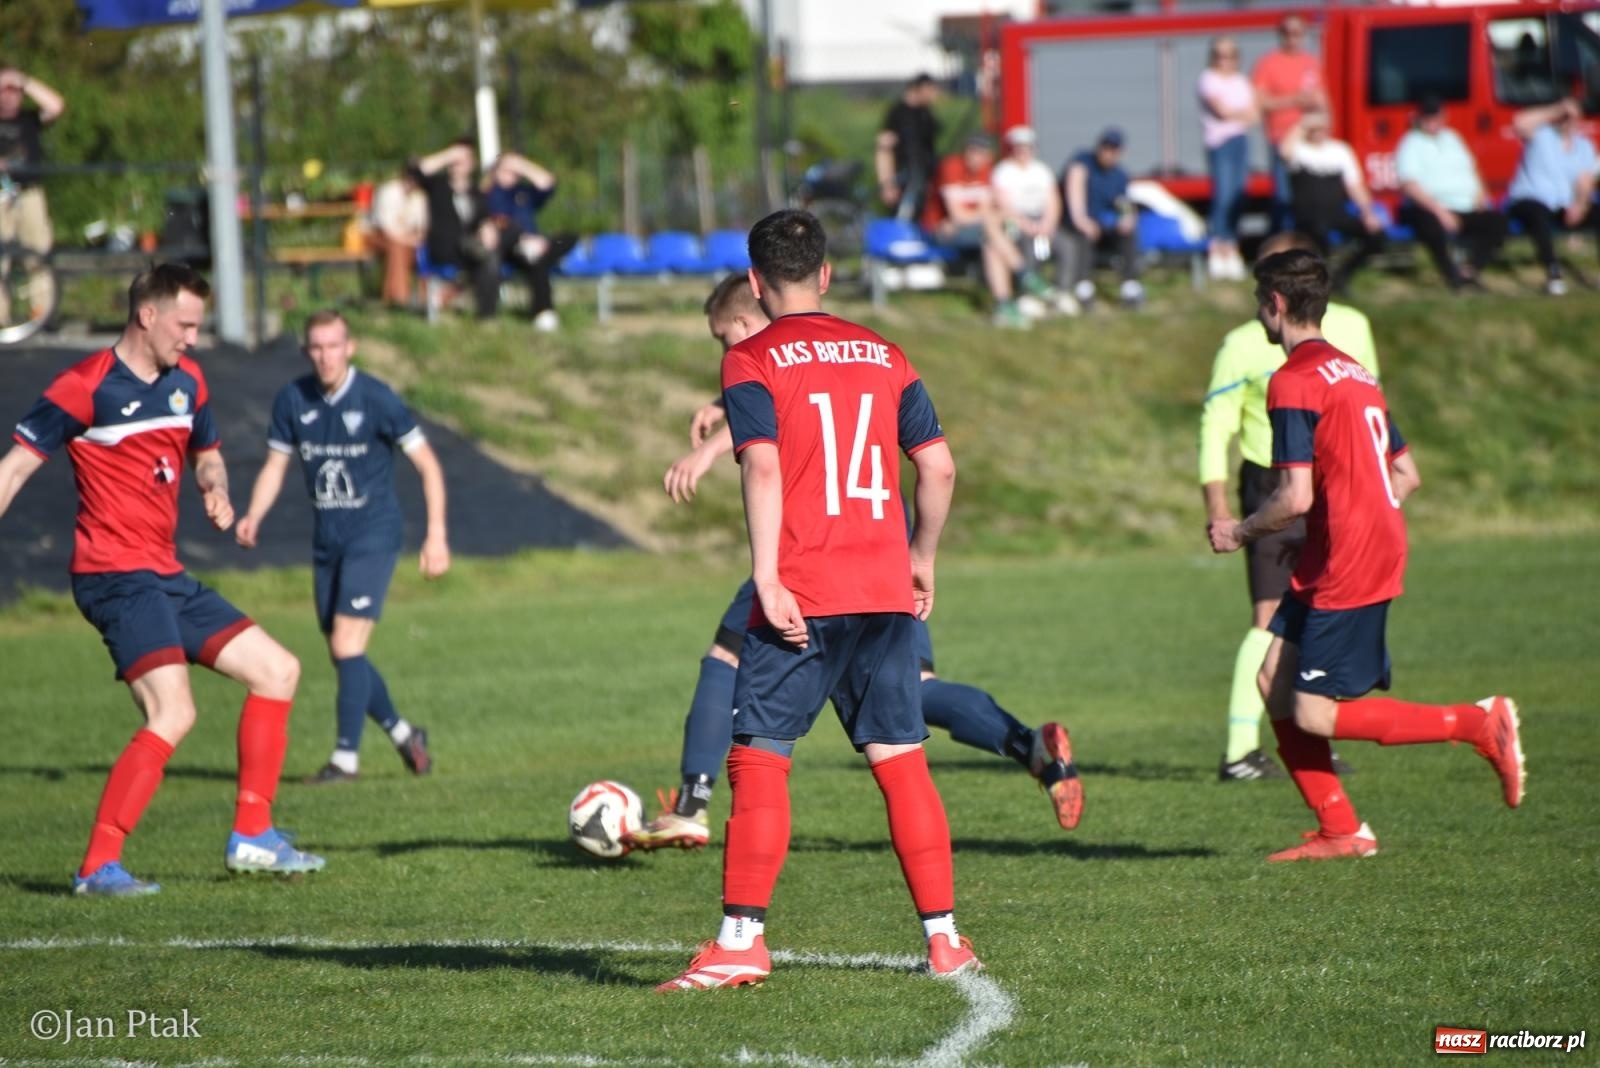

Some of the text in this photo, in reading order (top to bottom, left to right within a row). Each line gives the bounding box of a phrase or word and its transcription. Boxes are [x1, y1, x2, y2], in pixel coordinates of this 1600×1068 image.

[769, 340, 892, 368] LKS BRZEZIE
[809, 392, 890, 519] 14
